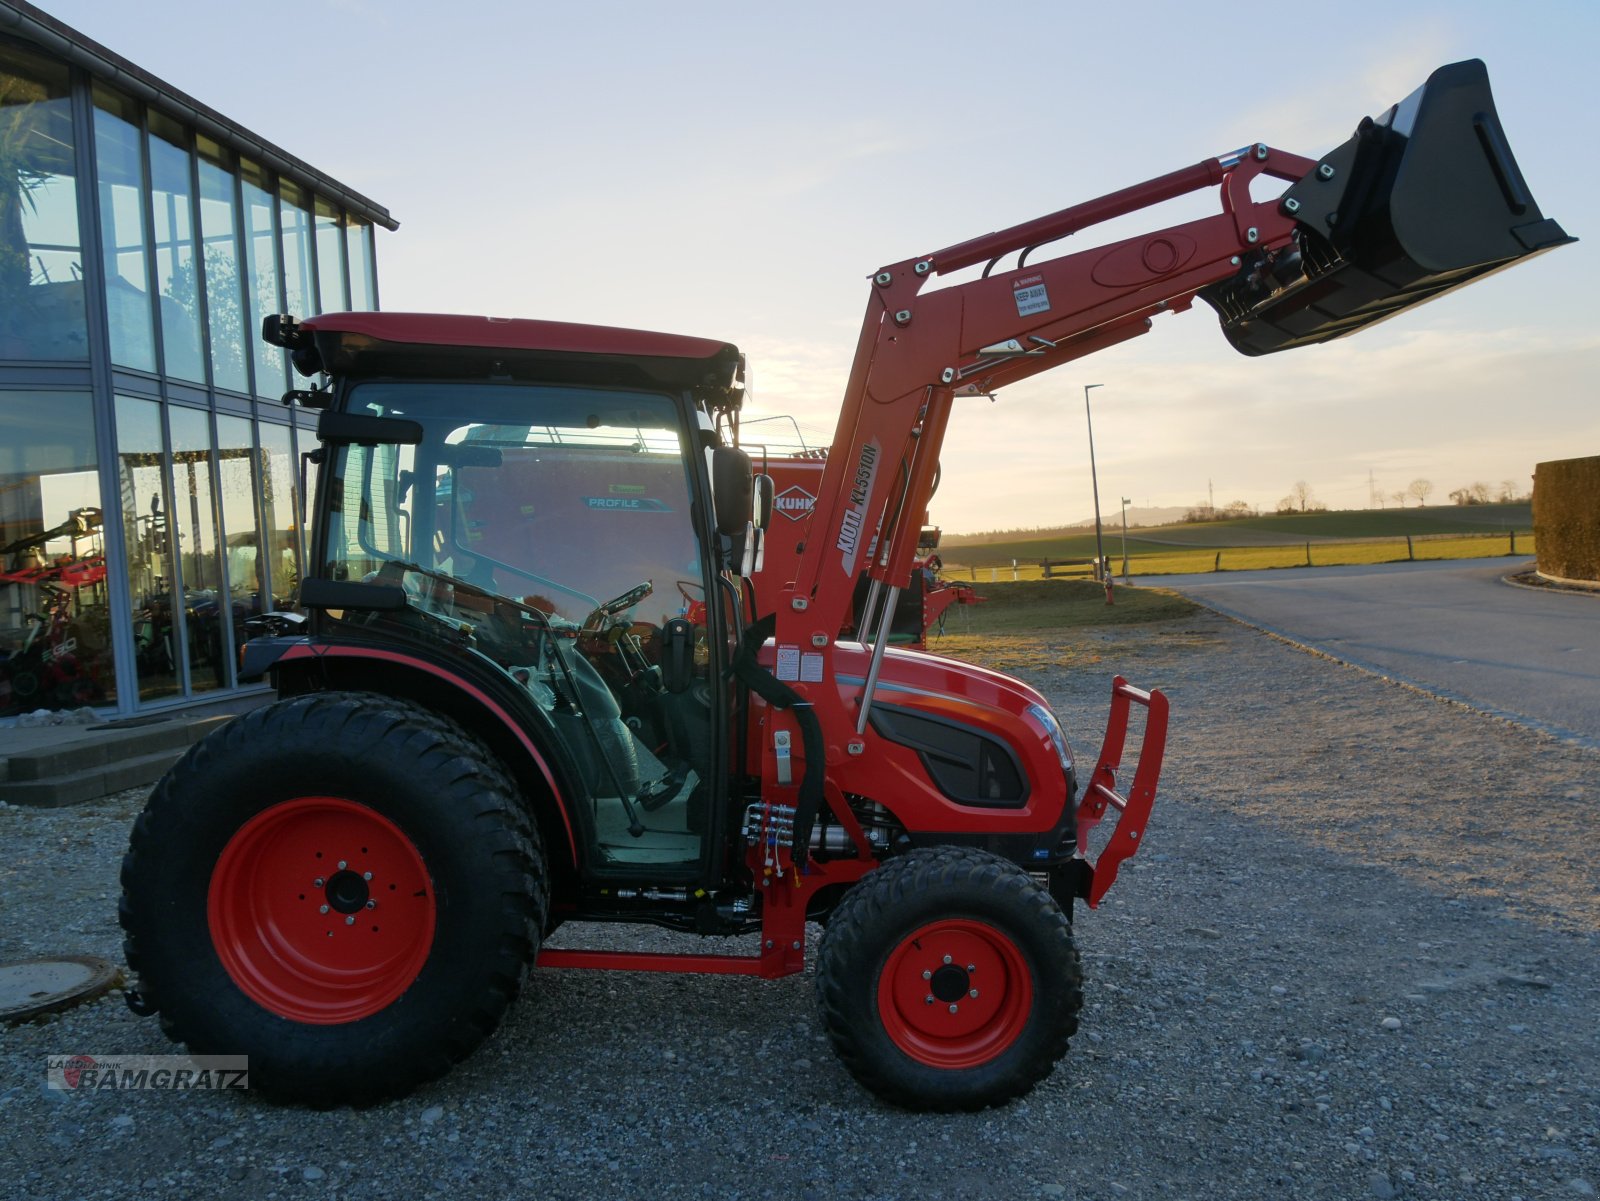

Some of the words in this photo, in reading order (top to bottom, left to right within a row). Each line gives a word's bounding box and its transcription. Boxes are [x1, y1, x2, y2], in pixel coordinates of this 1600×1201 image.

[588, 498, 640, 508] PROFILE
[776, 497, 814, 510] KUHN
[836, 508, 862, 555] KIOTI
[850, 444, 877, 506] KL5510N
